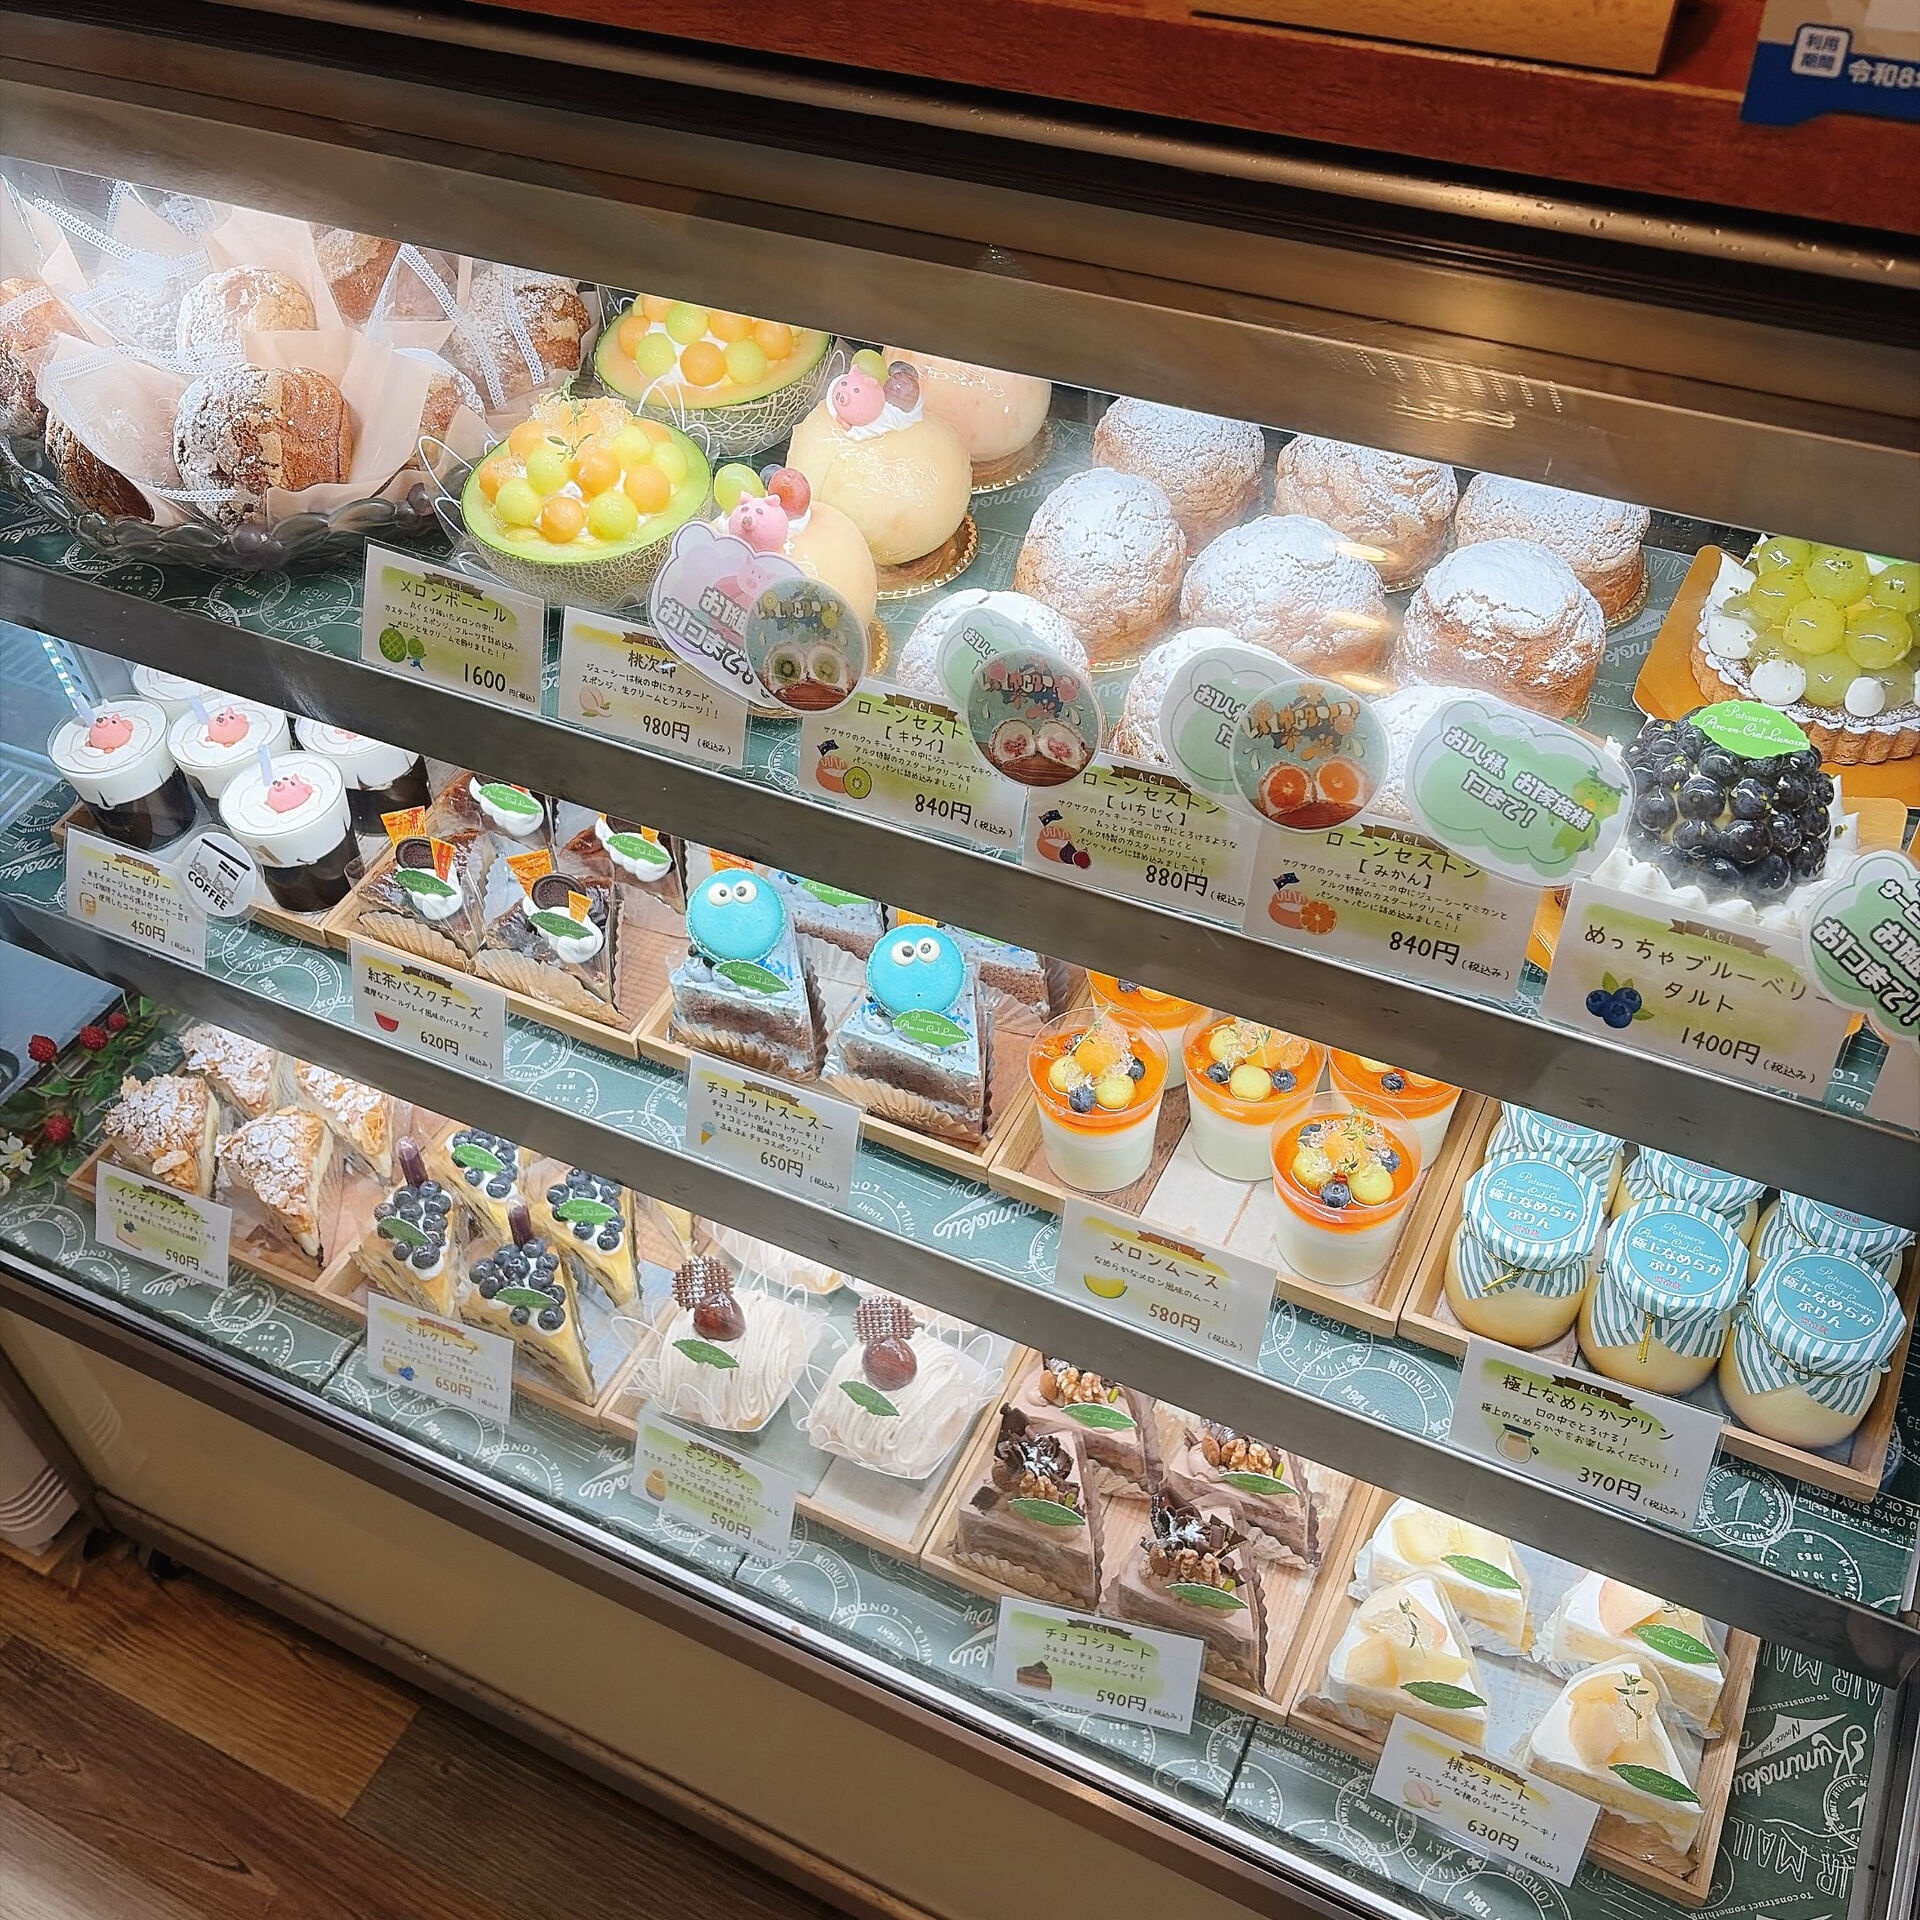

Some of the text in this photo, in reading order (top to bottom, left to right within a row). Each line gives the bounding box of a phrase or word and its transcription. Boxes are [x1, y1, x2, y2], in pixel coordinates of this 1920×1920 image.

[464, 663, 506, 692] 1600
[643, 715, 690, 742] 980円
[914, 794, 972, 826] 840円
[1083, 772, 1220, 815] ローンセストン
[1326, 832, 1480, 878] ローンセストン
[102, 860, 171, 890] コーヒーゼリー
[187, 870, 228, 911] COFFEE
[1145, 865, 1208, 897] 880円
[131, 920, 165, 943] 450円
[1389, 931, 1460, 966] 840円
[367, 966, 484, 1020] 紅茶バスクチーズ
[1665, 981, 1735, 1014] タルト
[420, 1031, 459, 1056] 620円
[1681, 1026, 1761, 1066] 1400円
[707, 1080, 833, 1131] チョコットスースー
[760, 1151, 804, 1178] 650円
[119, 1187, 210, 1224] インディアンサマー
[1488, 1187, 1577, 1222] 極上なめらか
[1507, 1207, 1551, 1230] ぷりん
[165, 1249, 199, 1271] 590円
[1110, 1240, 1218, 1290] メロンムース
[1631, 1236, 1722, 1276] 極上なめらか
[1649, 1259, 1693, 1284] ぷりん
[1781, 1274, 1875, 1327] 極上なめらか
[1796, 1299, 1842, 1329] ぷりん
[1148, 1303, 1201, 1334] 580円
[405, 1323, 479, 1356] ミルクレープ
[435, 1377, 472, 1399] 650円
[1503, 1374, 1674, 1440] 極上なめらかプリン
[684, 1446, 744, 1479] モンブラン
[1578, 1467, 1641, 1501] 370円
[710, 1512, 752, 1540] 590円
[1045, 1628, 1151, 1660] チョコショート
[1096, 1690, 1146, 1712] 590円
[1447, 1756, 1530, 1801] 桃ショート
[1467, 1819, 1519, 1852] 630円
